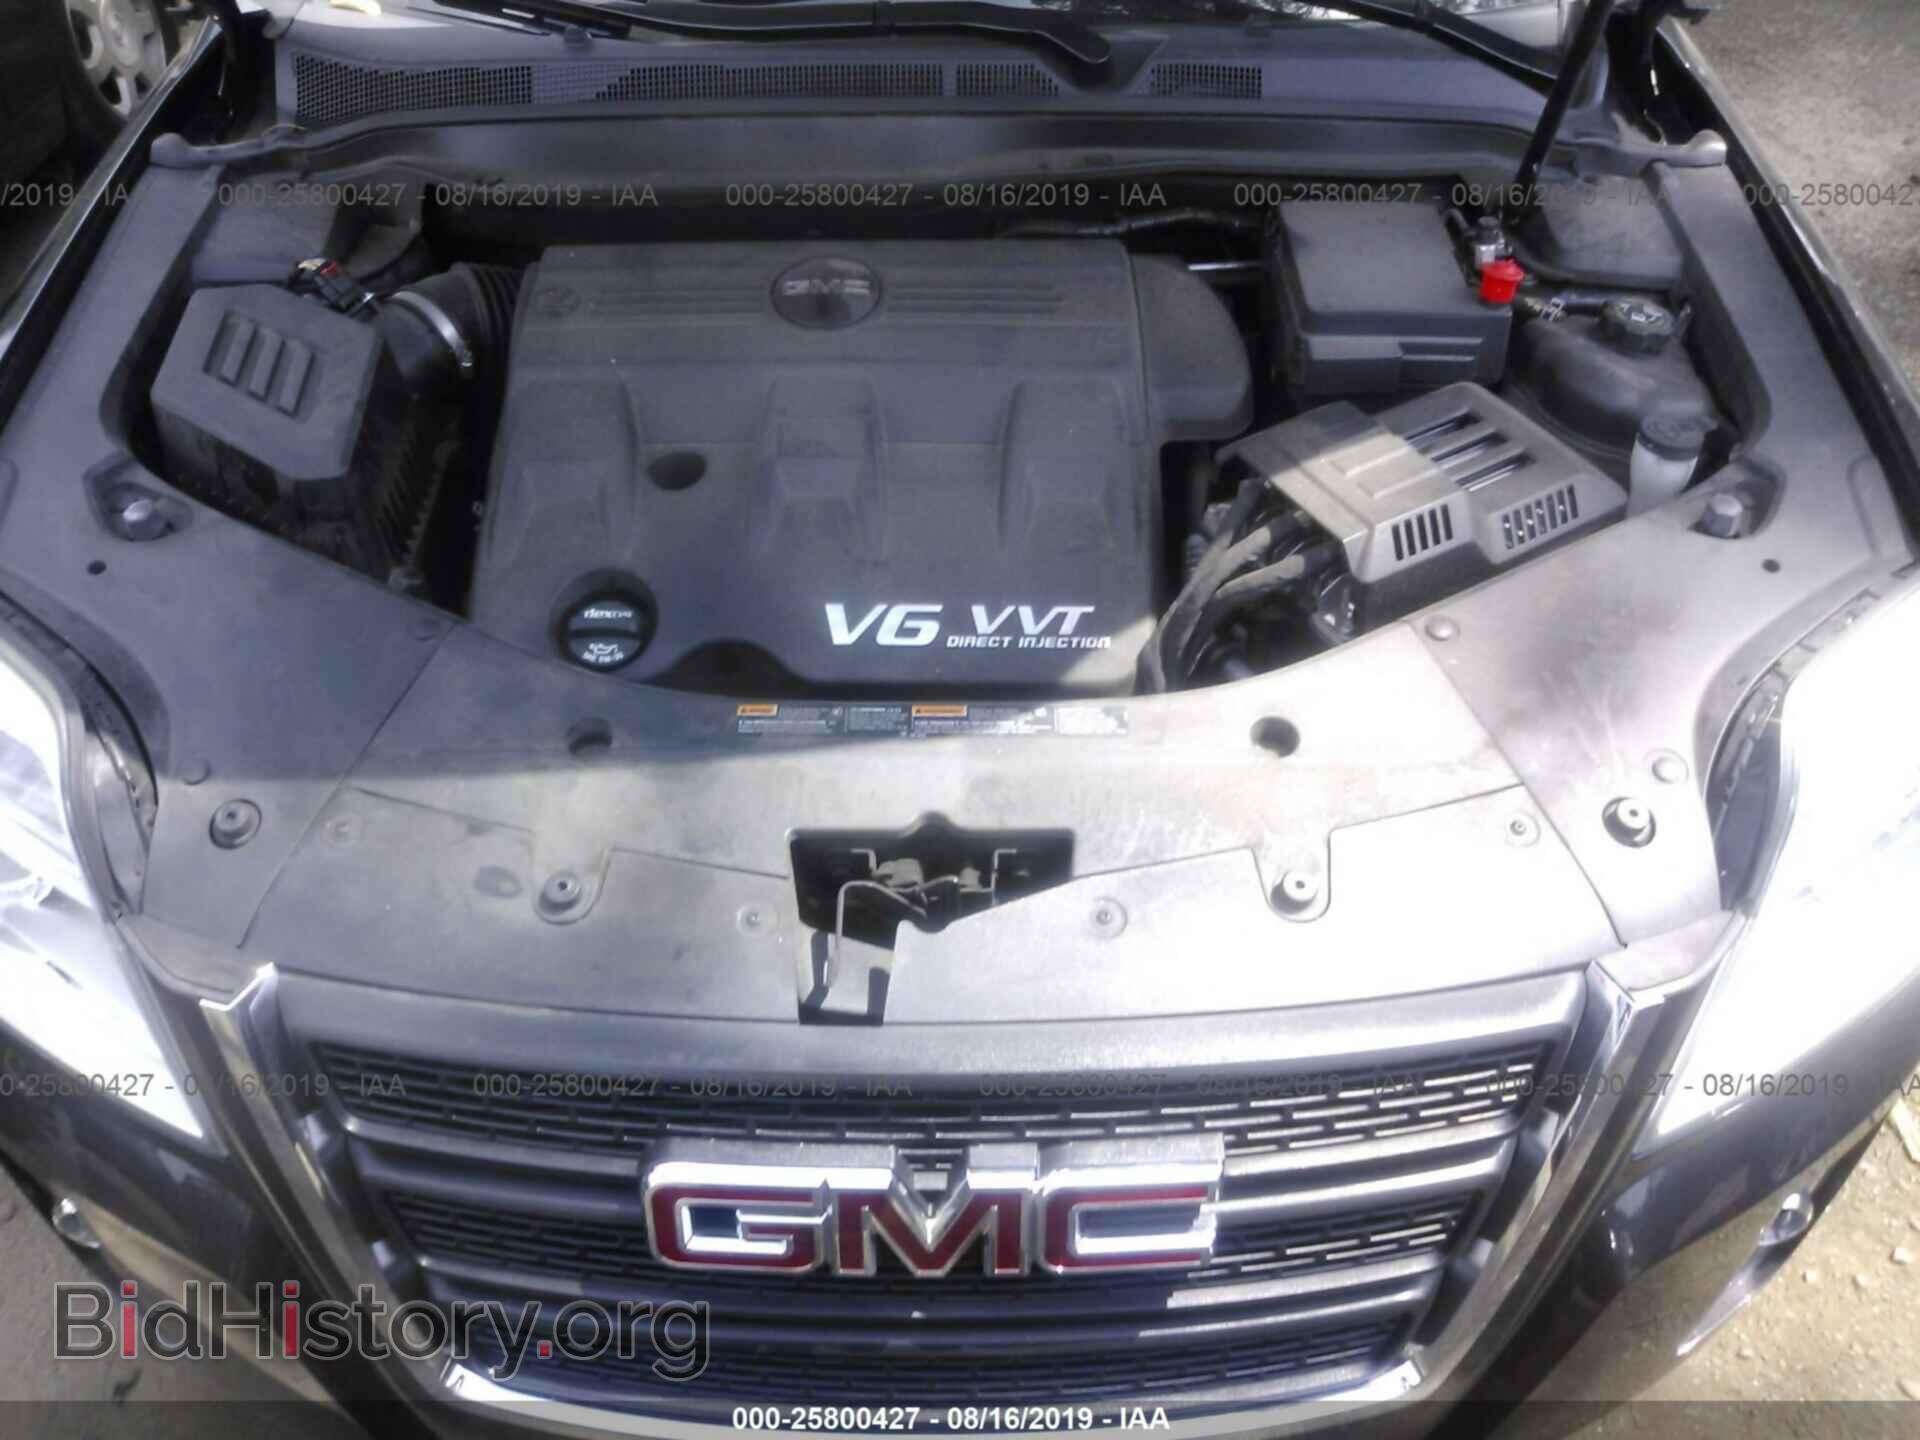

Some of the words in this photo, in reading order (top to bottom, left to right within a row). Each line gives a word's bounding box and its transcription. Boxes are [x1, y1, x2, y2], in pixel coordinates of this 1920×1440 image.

[825, 603, 943, 646] V6
[971, 605, 1095, 636] VVT
[947, 635, 1012, 649] DIRECT
[1018, 635, 1111, 649] INJECTION
[644, 1138, 1225, 1278] GMC
